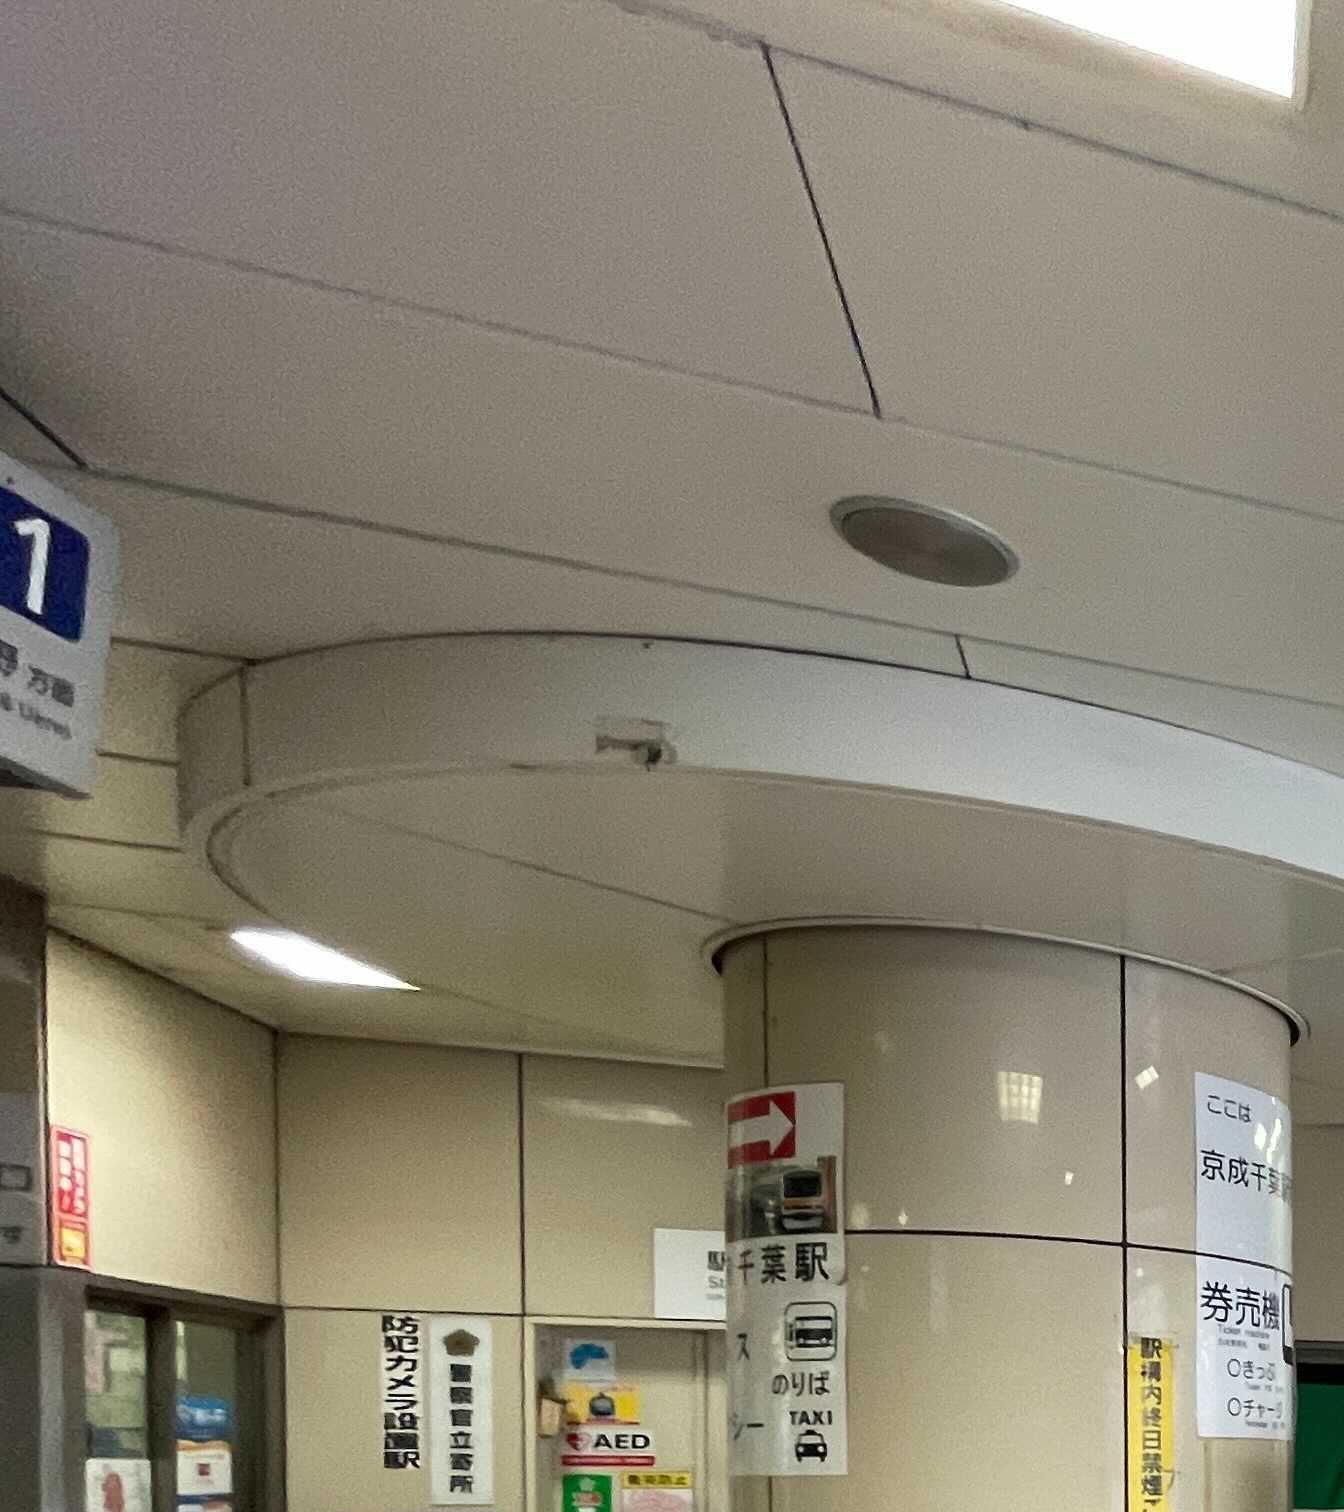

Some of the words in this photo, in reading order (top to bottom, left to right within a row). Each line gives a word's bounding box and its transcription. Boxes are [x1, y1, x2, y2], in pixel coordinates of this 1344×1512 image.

[14, 517, 51, 616] 1
[1206, 1094, 1252, 1123] ここは
[736, 1241, 831, 1286] 千葉駅
[1200, 1280, 1280, 1331] 券売機
[771, 1369, 831, 1397] のりば
[788, 1410, 832, 1426] TAXI
[593, 1433, 652, 1451] AED
